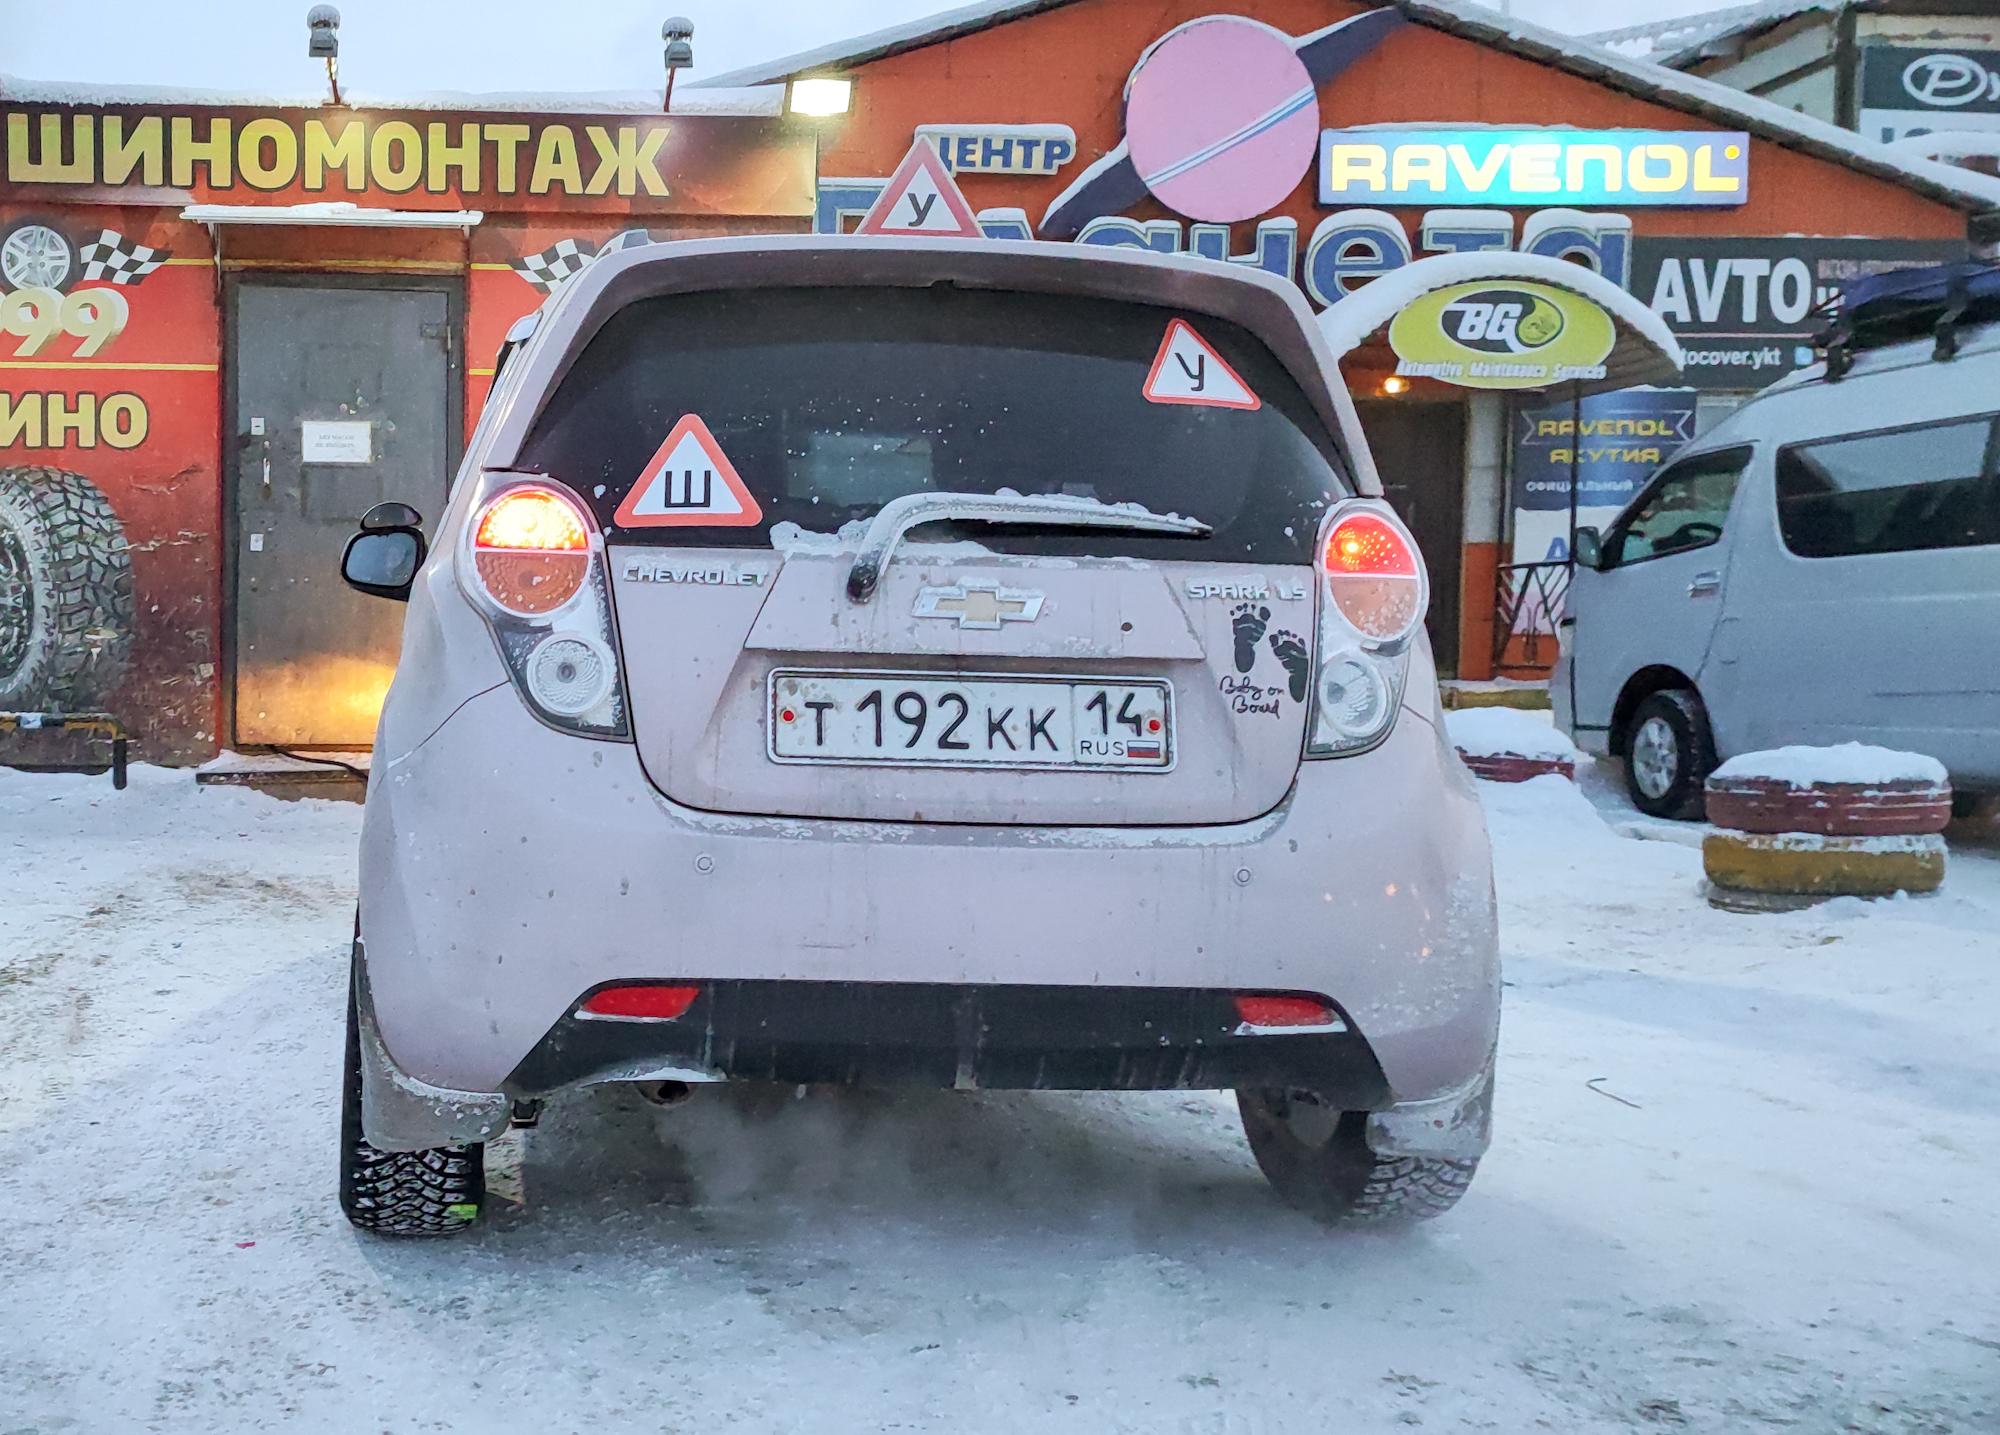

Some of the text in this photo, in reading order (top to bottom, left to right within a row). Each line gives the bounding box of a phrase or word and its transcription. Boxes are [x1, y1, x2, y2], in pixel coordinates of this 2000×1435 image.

[6, 112, 672, 198] ШИНОМОНТАЖ
[1330, 143, 1741, 193] RAVENOL
[907, 192, 938, 228] У
[1650, 257, 1812, 325] AVTO
[0, 287, 125, 358] 99
[1448, 301, 1524, 345] BG
[1174, 351, 1205, 392] У
[1537, 419, 1675, 437] RAVENOL
[664, 470, 711, 508] Ш
[1525, 479, 1634, 493] ОФИЦАЛЬНЫЙ
[622, 563, 770, 588] CHEVROLET
[1187, 582, 1270, 600] SPARK
[1219, 675, 1286, 701] Baby on
[1085, 690, 1143, 738] 14
[1231, 694, 1281, 720] Board
[1080, 739, 1125, 758] RUS
